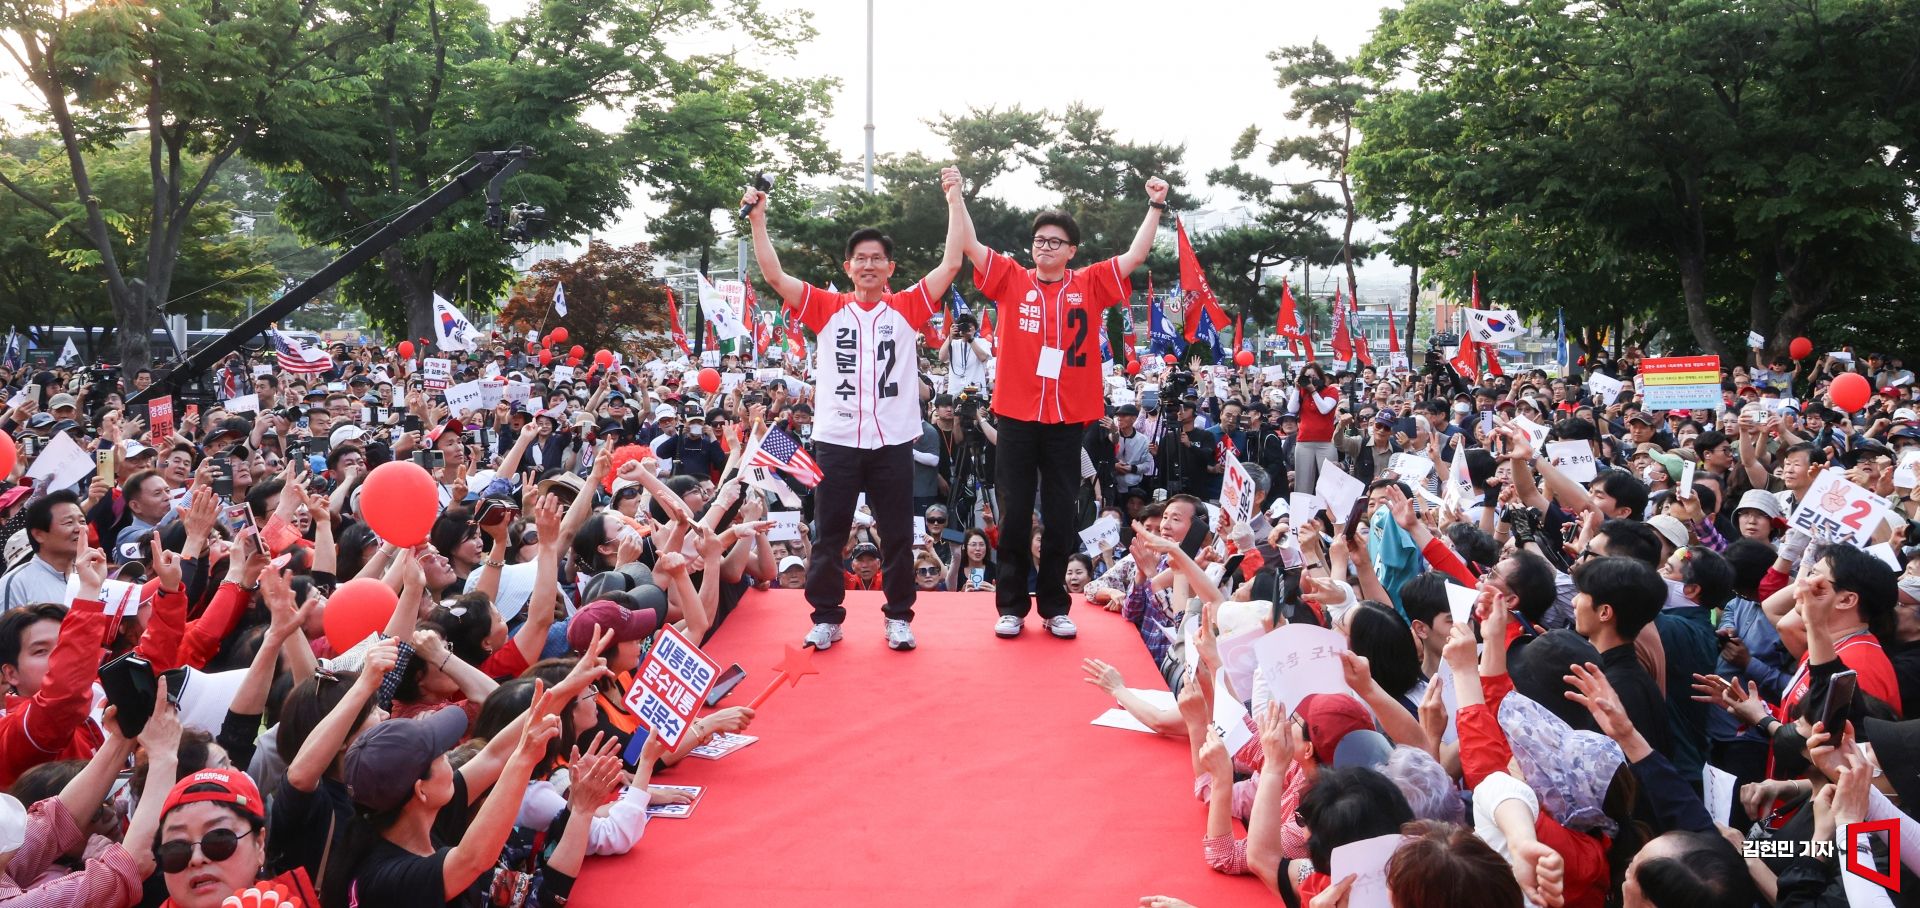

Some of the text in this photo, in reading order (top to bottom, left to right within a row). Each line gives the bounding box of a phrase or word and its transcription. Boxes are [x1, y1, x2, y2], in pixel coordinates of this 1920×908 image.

[1019, 302, 1041, 318] 국민
[1019, 318, 1040, 334] 의힘
[1067, 308, 1088, 367] 2
[835, 328, 856, 400] 김문수
[877, 339, 898, 400] 2
[1840, 500, 1872, 530] 2
[642, 660, 696, 716] 문수대통
[656, 636, 710, 692] 대통령은
[630, 686, 680, 738] 2 김문수
